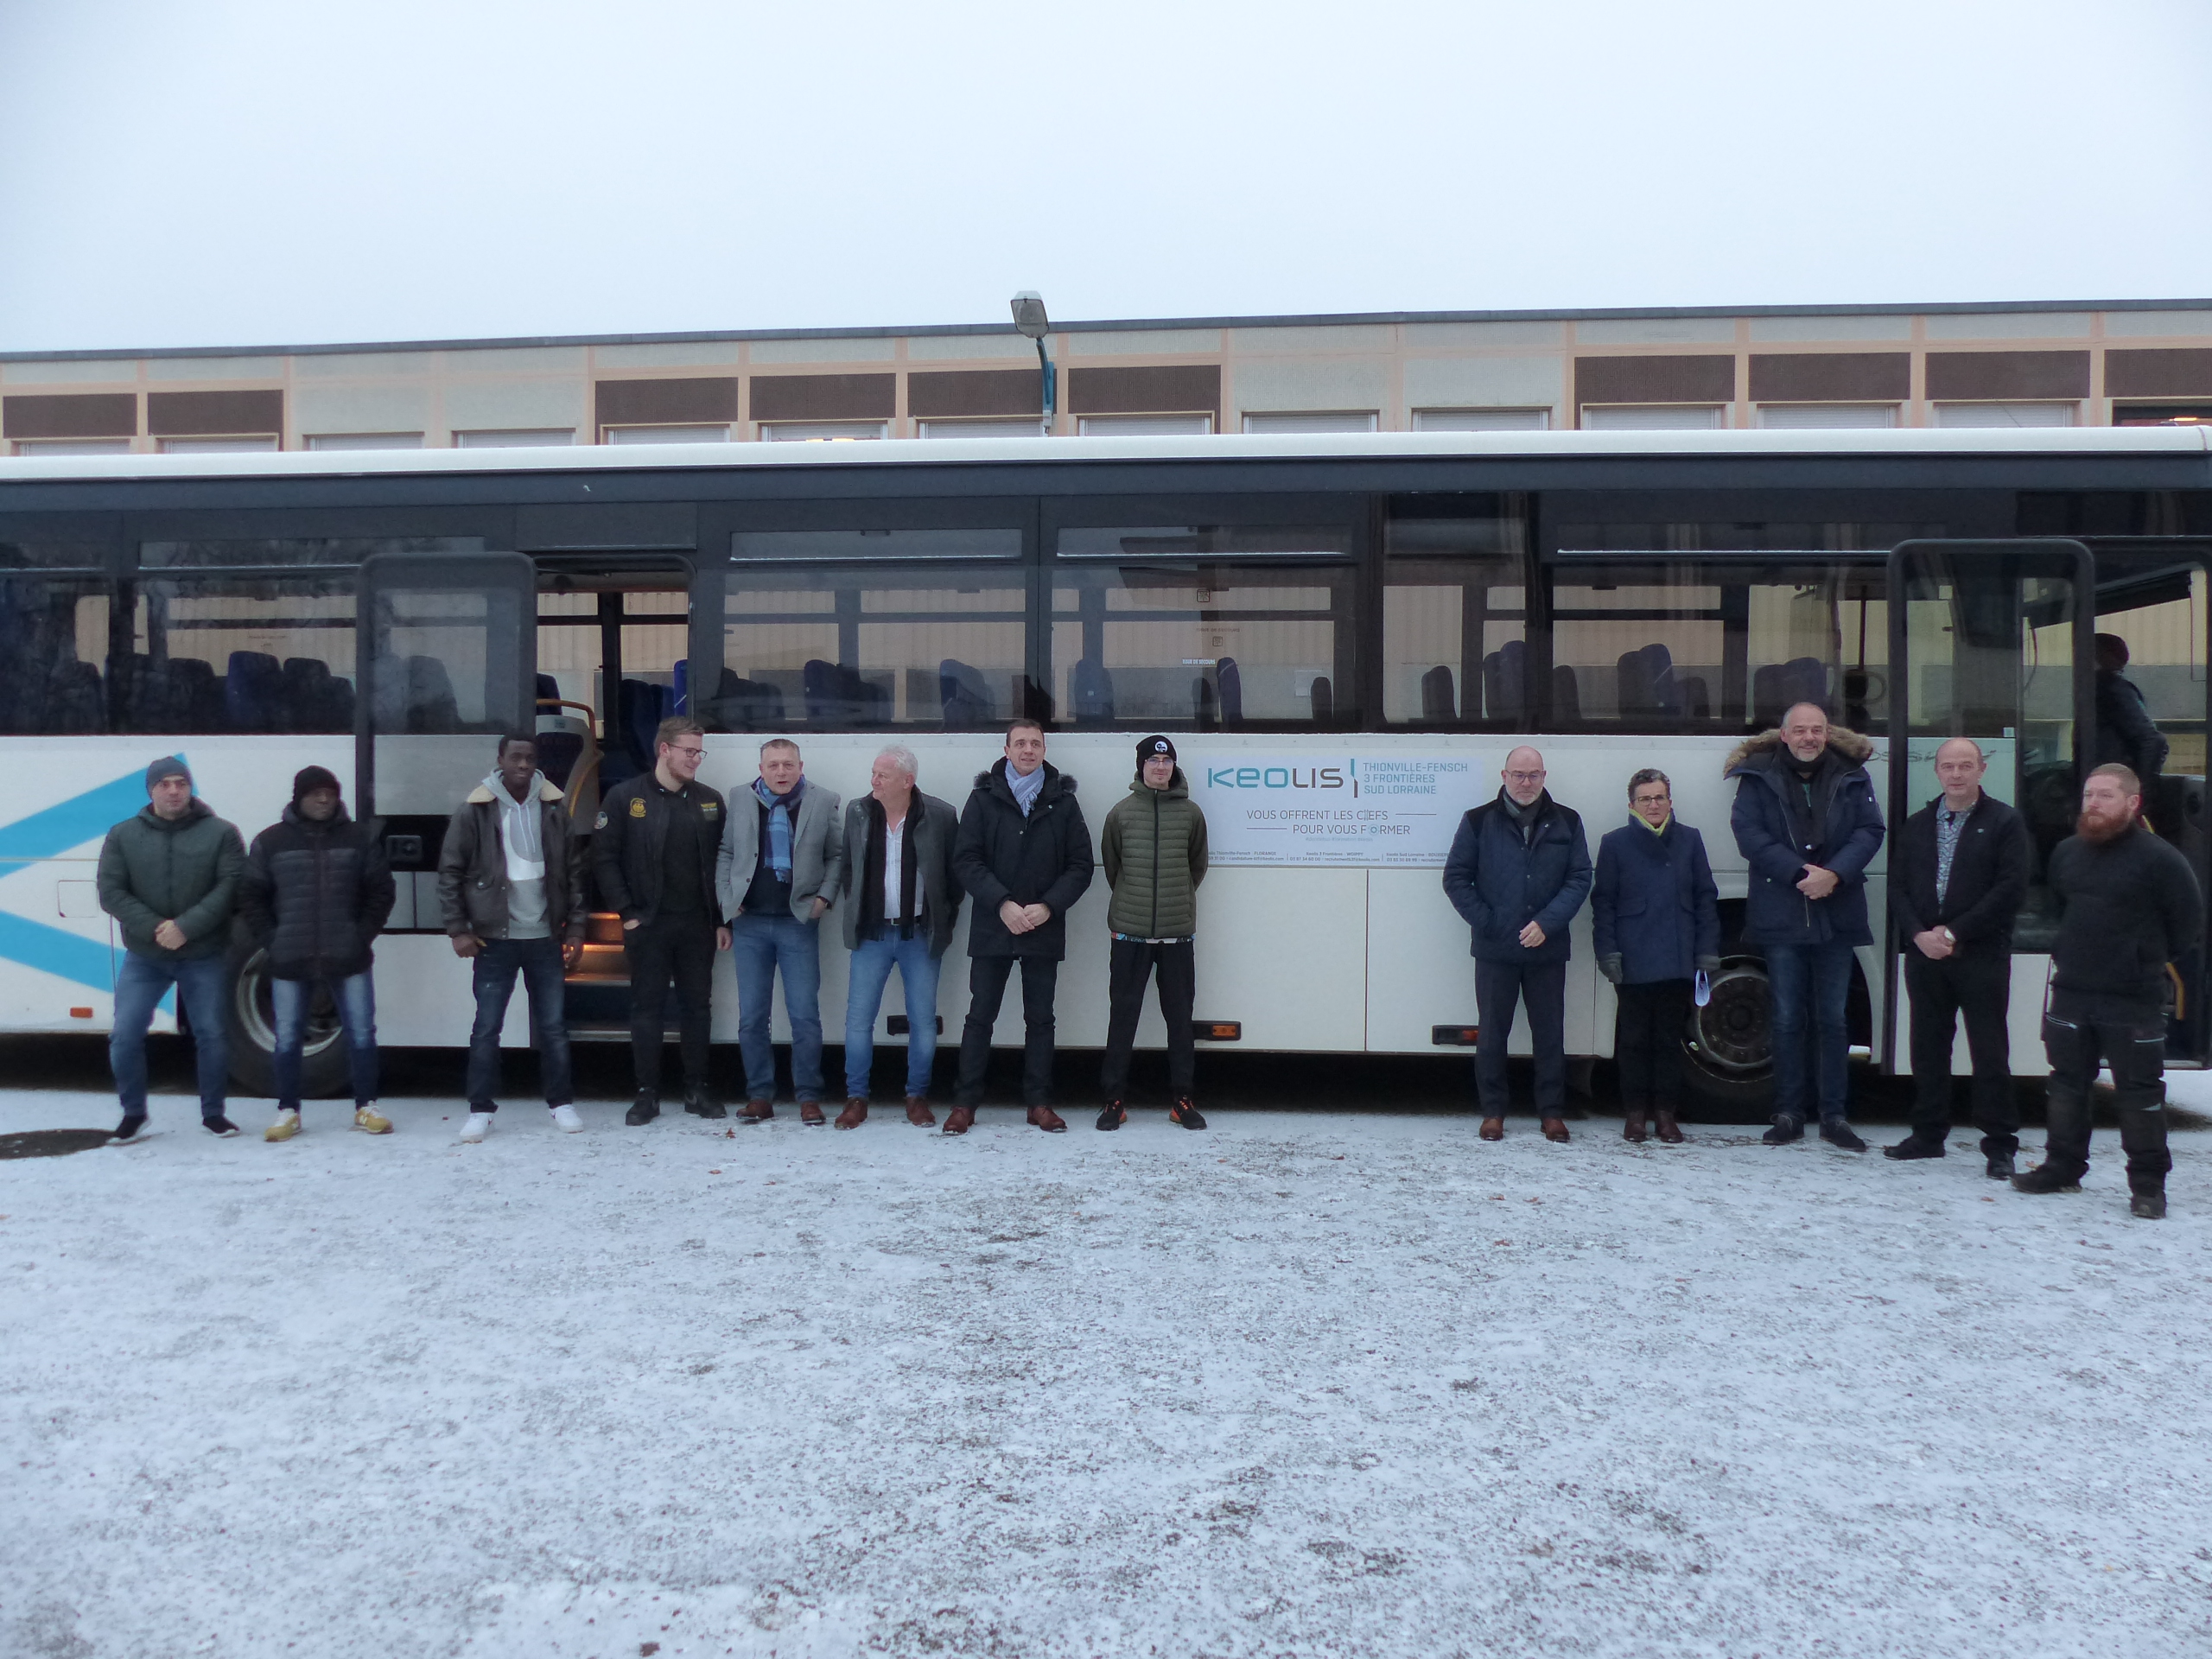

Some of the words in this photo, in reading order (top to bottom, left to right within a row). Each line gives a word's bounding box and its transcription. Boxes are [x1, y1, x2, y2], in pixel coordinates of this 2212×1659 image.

[1363, 762, 1468, 772] THIONVILLE-FENSCH
[1363, 773, 1370, 783] 3
[1373, 772, 1435, 783] FRONTIÈRES
[1363, 785, 1384, 794] SUD
[1387, 785, 1436, 794] LORRAINE
[1247, 810, 1276, 820] VOUS
[1280, 810, 1330, 820] OFFRENT
[1333, 810, 1353, 820] LES
[1293, 824, 1324, 835] POUR
[1326, 824, 1357, 835] VOUS
[1360, 823, 1411, 836] FORMER
